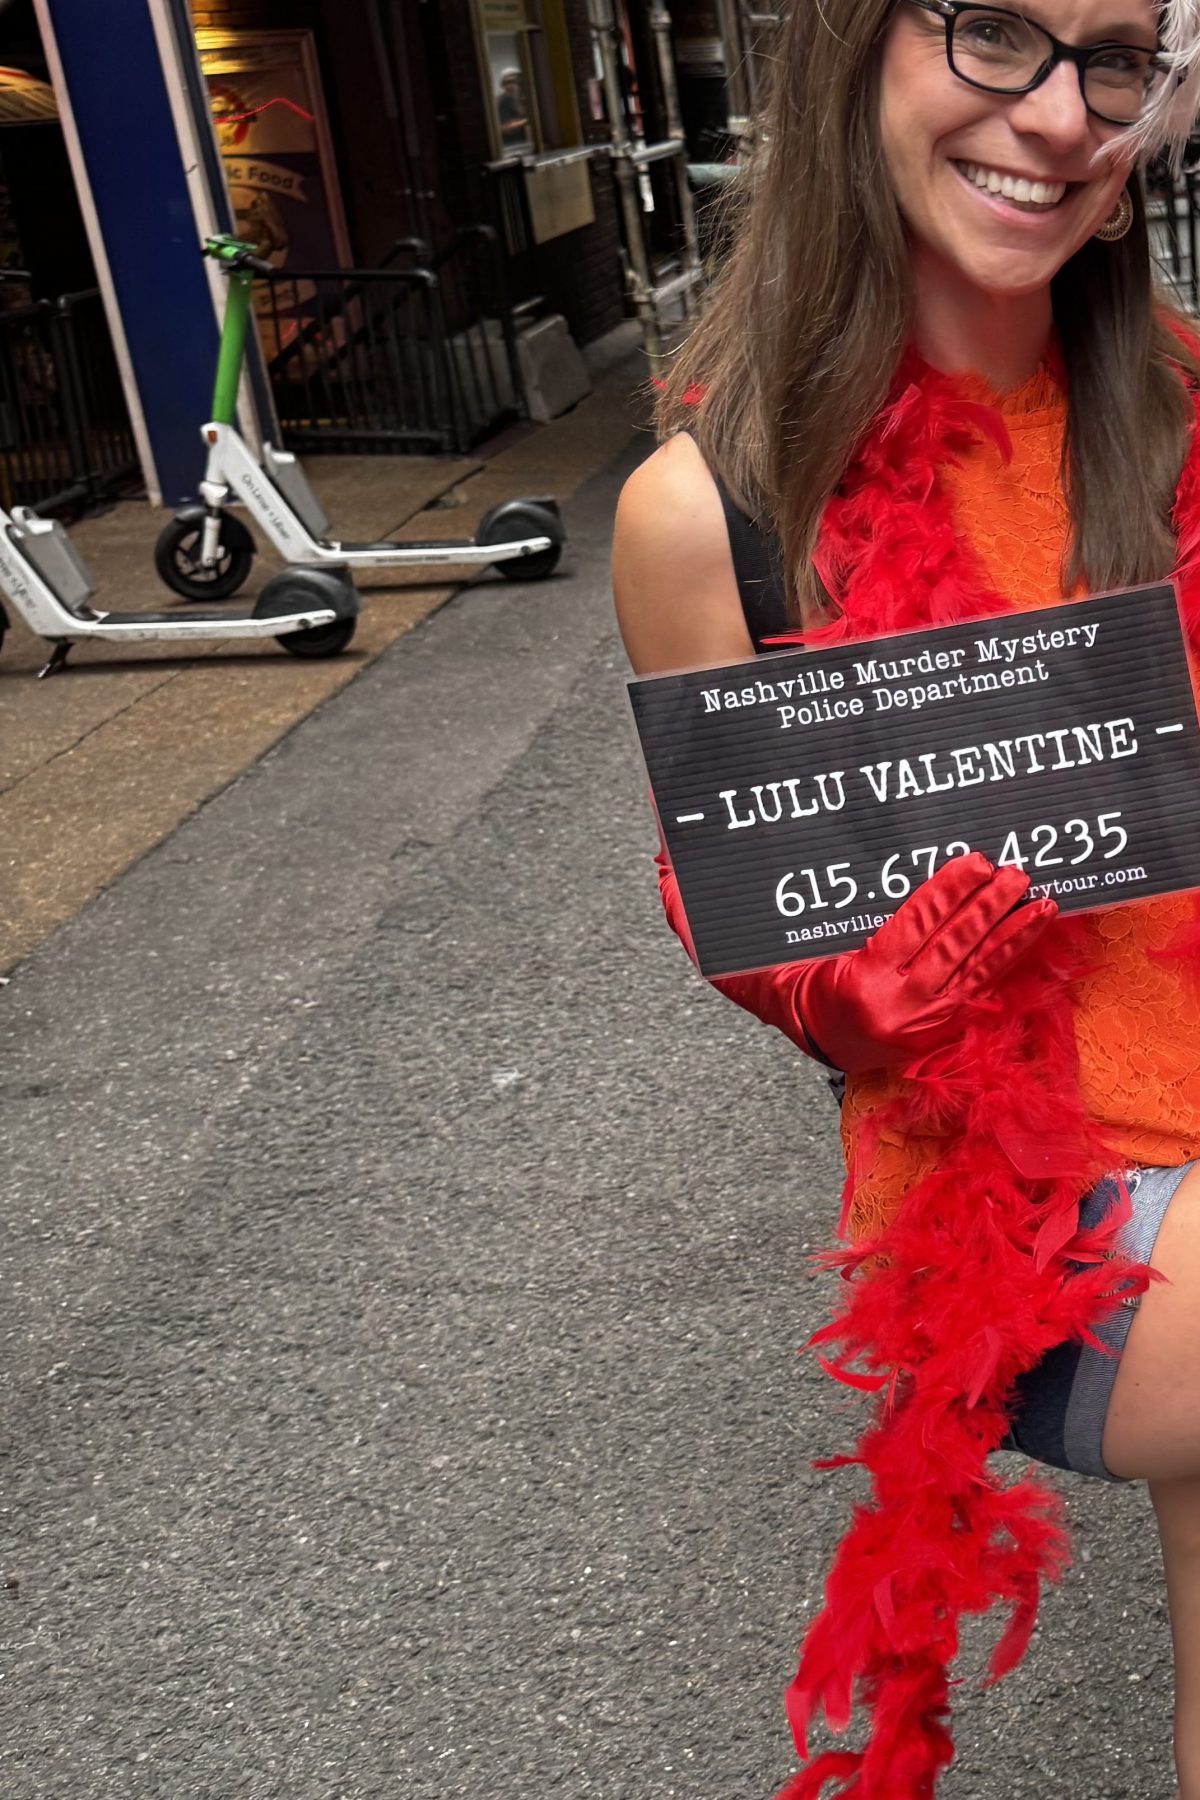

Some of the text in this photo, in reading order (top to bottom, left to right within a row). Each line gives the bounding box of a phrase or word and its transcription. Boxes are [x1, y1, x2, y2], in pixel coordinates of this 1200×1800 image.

[248, 166, 294, 190] Food
[700, 623, 1100, 713] Nashville Murder Mystery
[776, 659, 1050, 729] Police Department
[718, 771, 846, 830] LULU
[859, 717, 1139, 803] VALENTINE
[775, 811, 1128, 917] 615.674235
